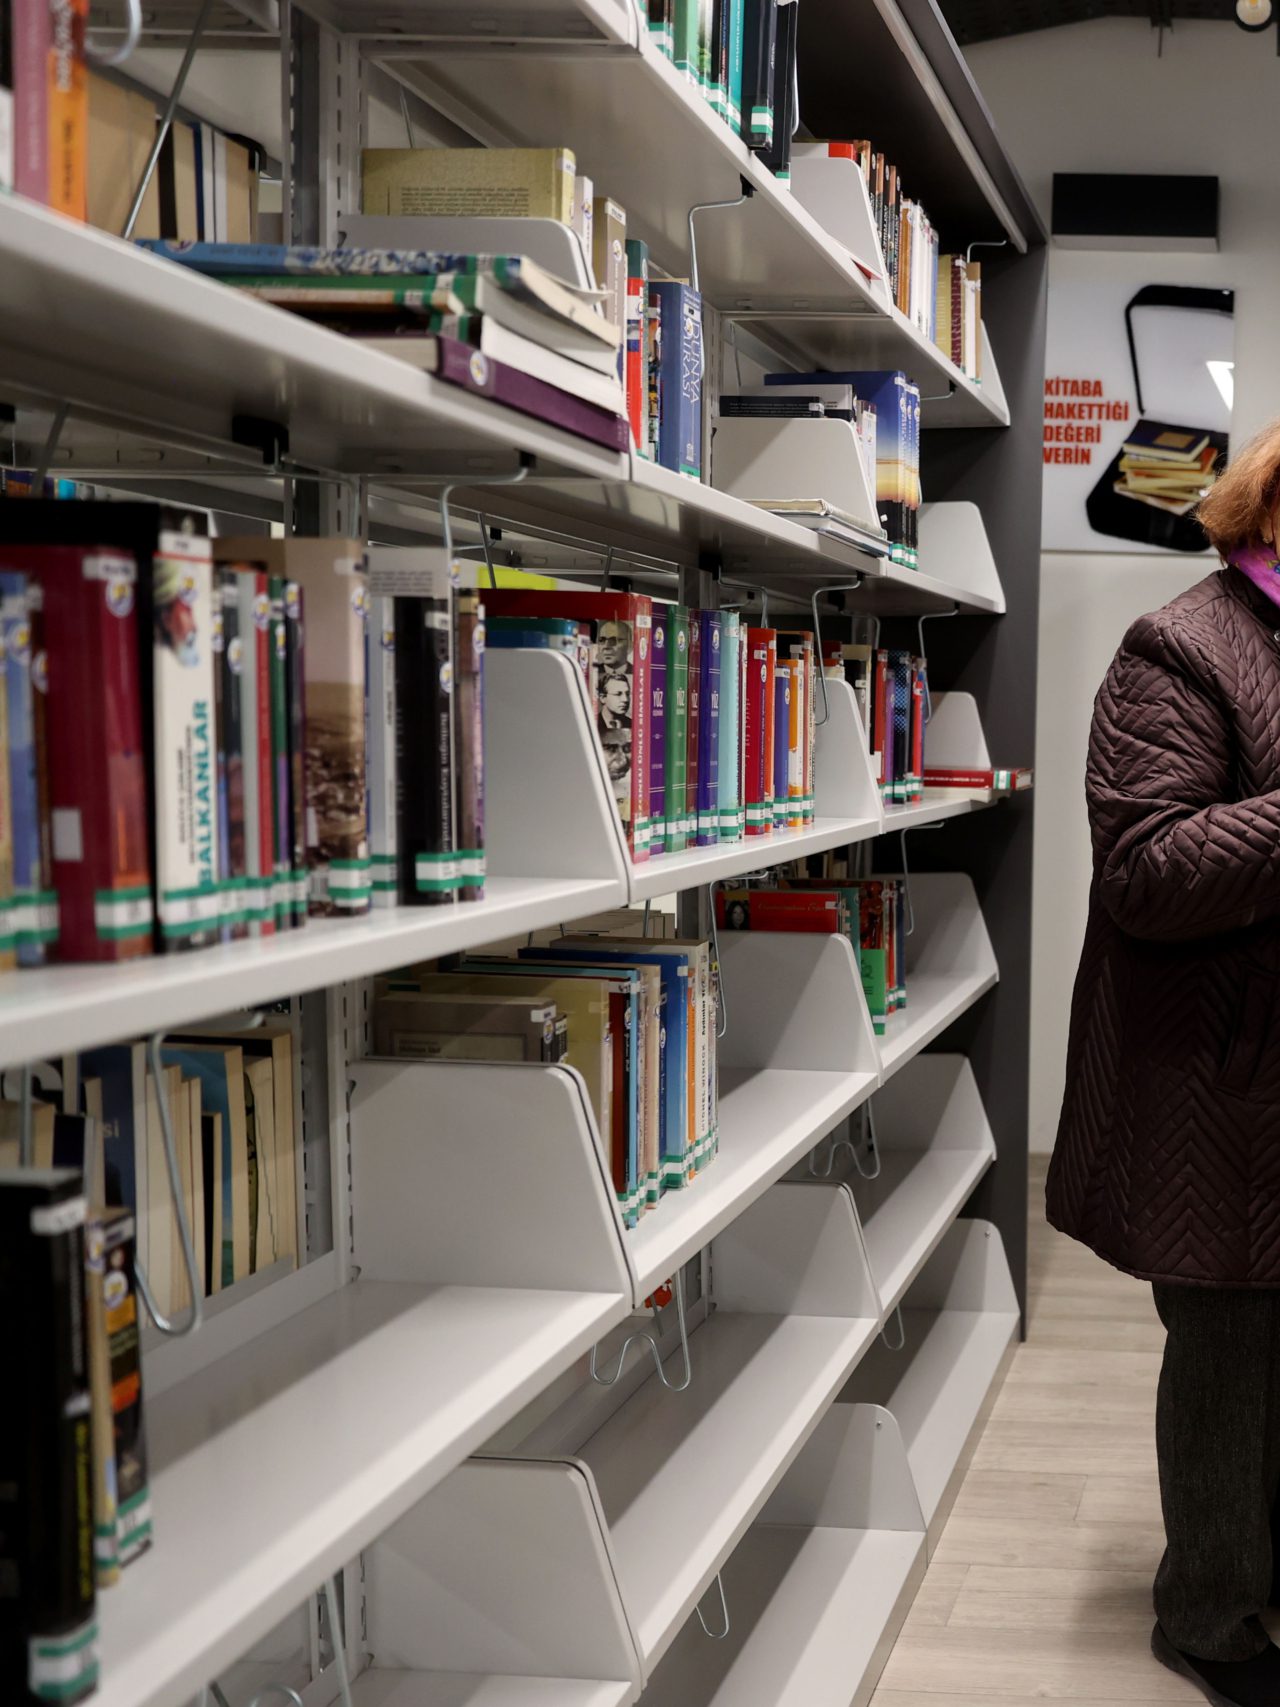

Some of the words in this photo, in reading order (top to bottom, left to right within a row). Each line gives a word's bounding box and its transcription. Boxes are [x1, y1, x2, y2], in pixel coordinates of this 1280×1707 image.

[1044, 376, 1103, 397] KİTABA
[1044, 400, 1129, 421] HAKETTİĞİ
[1043, 423, 1101, 443] DEĞERİ
[1043, 445, 1091, 464] VERİN
